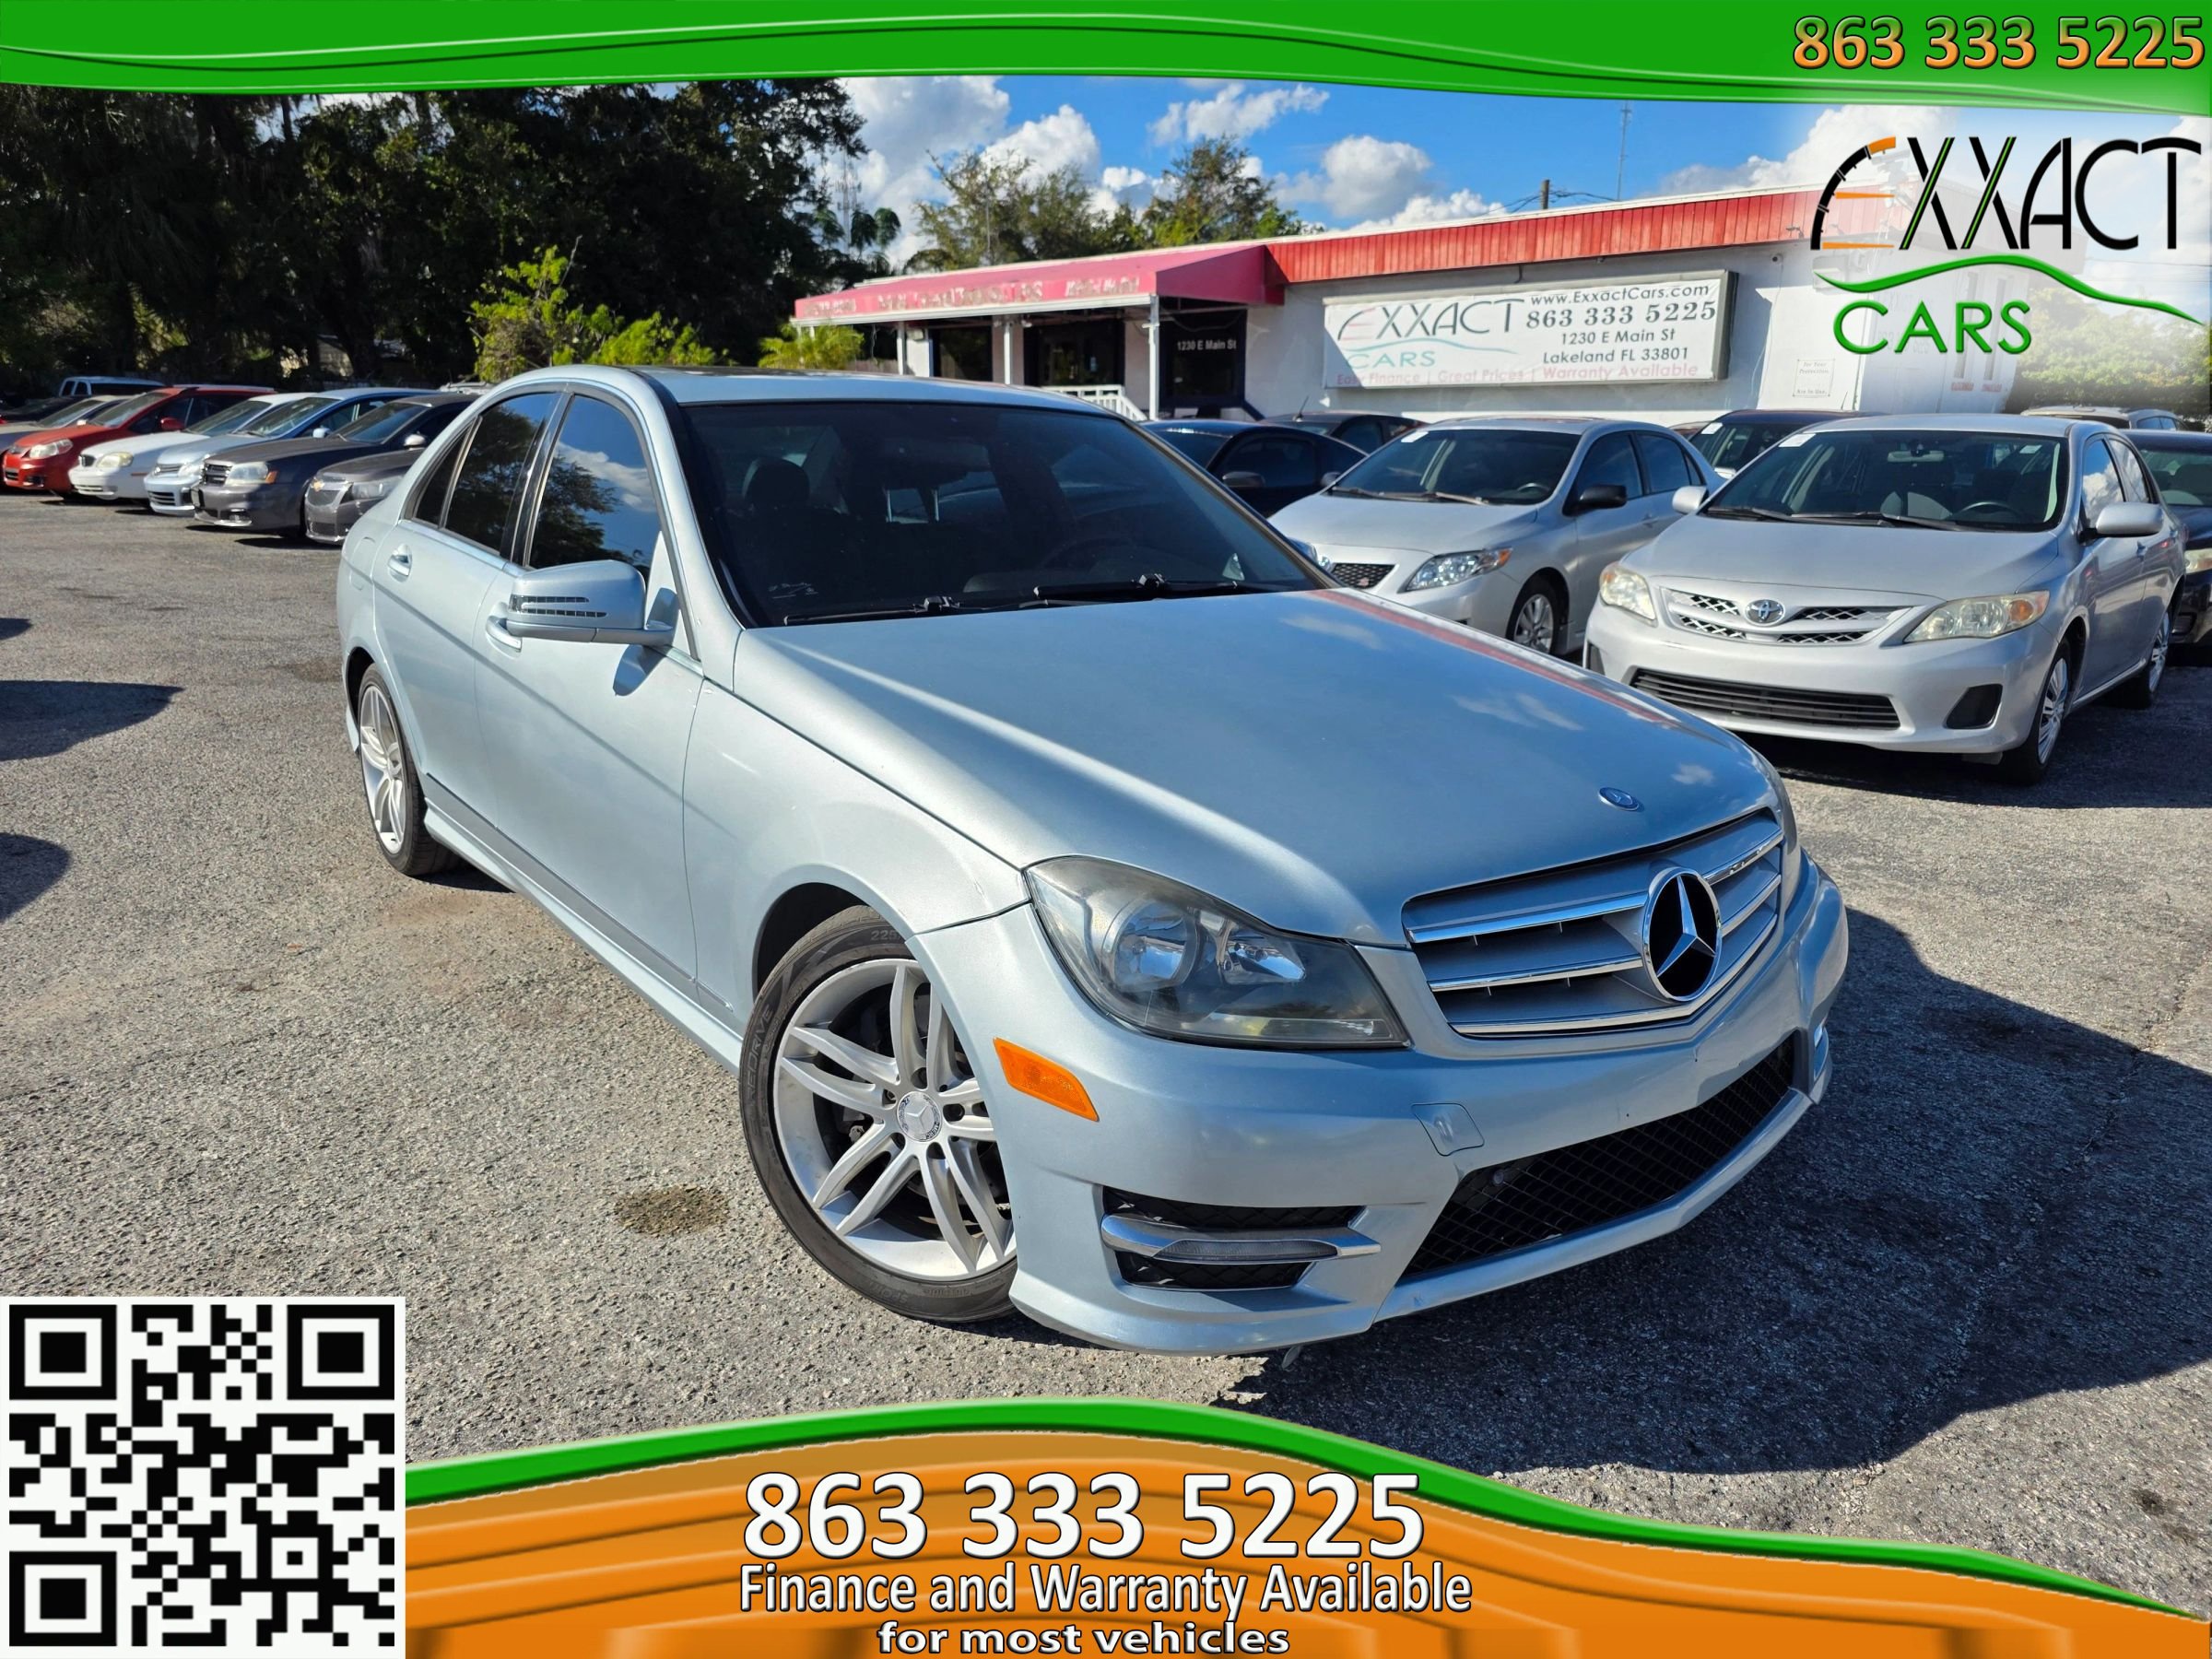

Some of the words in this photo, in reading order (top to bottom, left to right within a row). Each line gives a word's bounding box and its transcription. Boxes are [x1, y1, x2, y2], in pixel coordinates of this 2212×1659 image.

[1531, 285, 1709, 305] www.ExxactCars.com
[1337, 299, 1524, 341] EXXACT
[1526, 310, 1572, 329] 863
[1584, 305, 1633, 325] 333
[1645, 300, 1716, 323] 5225
[1177, 339, 1196, 350] 1230
[1205, 338, 1226, 349] Main
[1561, 333, 1596, 345] 1230
[1602, 332, 1609, 344] E
[1615, 330, 1654, 343] Main
[1661, 328, 1676, 341] St
[1347, 351, 1436, 369] CARS
[1543, 349, 1614, 364] Lakeland
[1621, 348, 1635, 361] FL
[1641, 347, 1688, 360] 33801
[1370, 371, 1419, 384] Finance
[1438, 371, 1475, 382] Great
[1482, 369, 1524, 382] Prices
[1543, 367, 1611, 381] Warranty
[1618, 363, 1698, 377] Available
